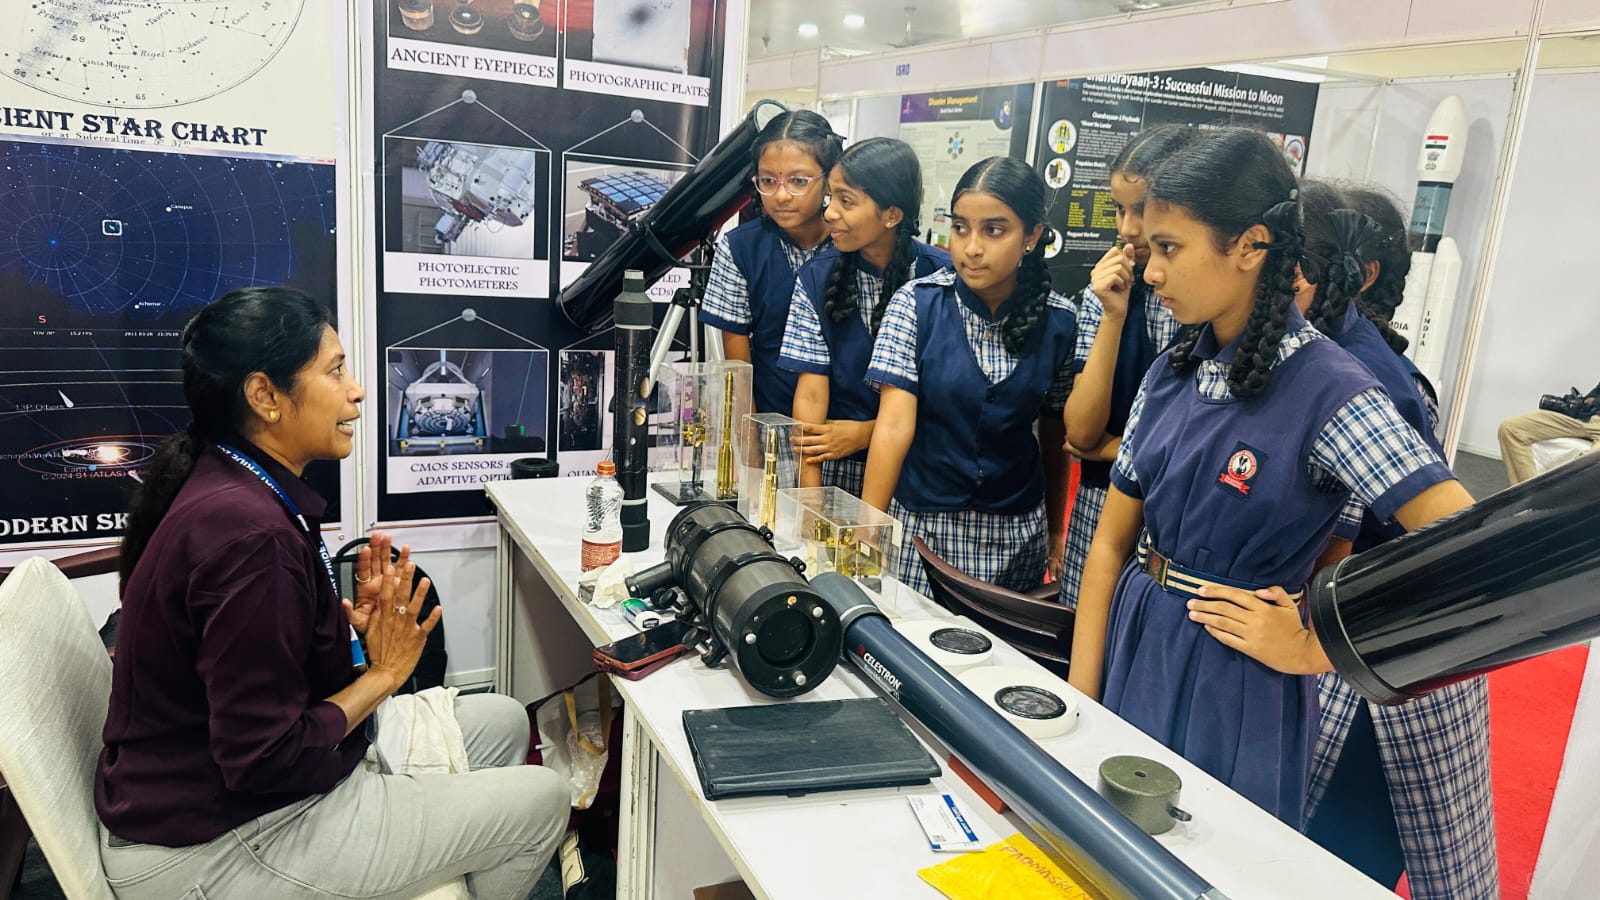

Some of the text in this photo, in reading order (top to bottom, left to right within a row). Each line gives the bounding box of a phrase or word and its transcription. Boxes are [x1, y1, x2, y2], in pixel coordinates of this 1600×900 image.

[100, 24, 126, 36] Orion
[71, 34, 86, 43] 59
[140, 50, 165, 60] Rigel
[106, 60, 132, 70] Major
[391, 47, 555, 80] ANCIENT EYEPIECES
[896, 63, 911, 76] ISRO
[569, 69, 710, 98] PHOTOGRAPHIC PLATES
[135, 93, 146, 101] 65
[1165, 77, 1212, 96] Successful
[1213, 83, 1247, 100] Mission
[1248, 89, 1258, 101] to
[1259, 89, 1284, 105] Moon
[0, 106, 267, 146] IENT STAR CHART
[417, 261, 520, 276] PHOTOELECTRIC
[419, 278, 519, 291] PHOTOMETERES
[38, 315, 46, 324] S
[410, 462, 449, 473] CMOS
[451, 459, 504, 471] SENSORS
[416, 472, 513, 486] ADAPTIVE OPTIC
[0, 512, 130, 537] ODERN SK
[863, 652, 902, 690] CELESTRON
